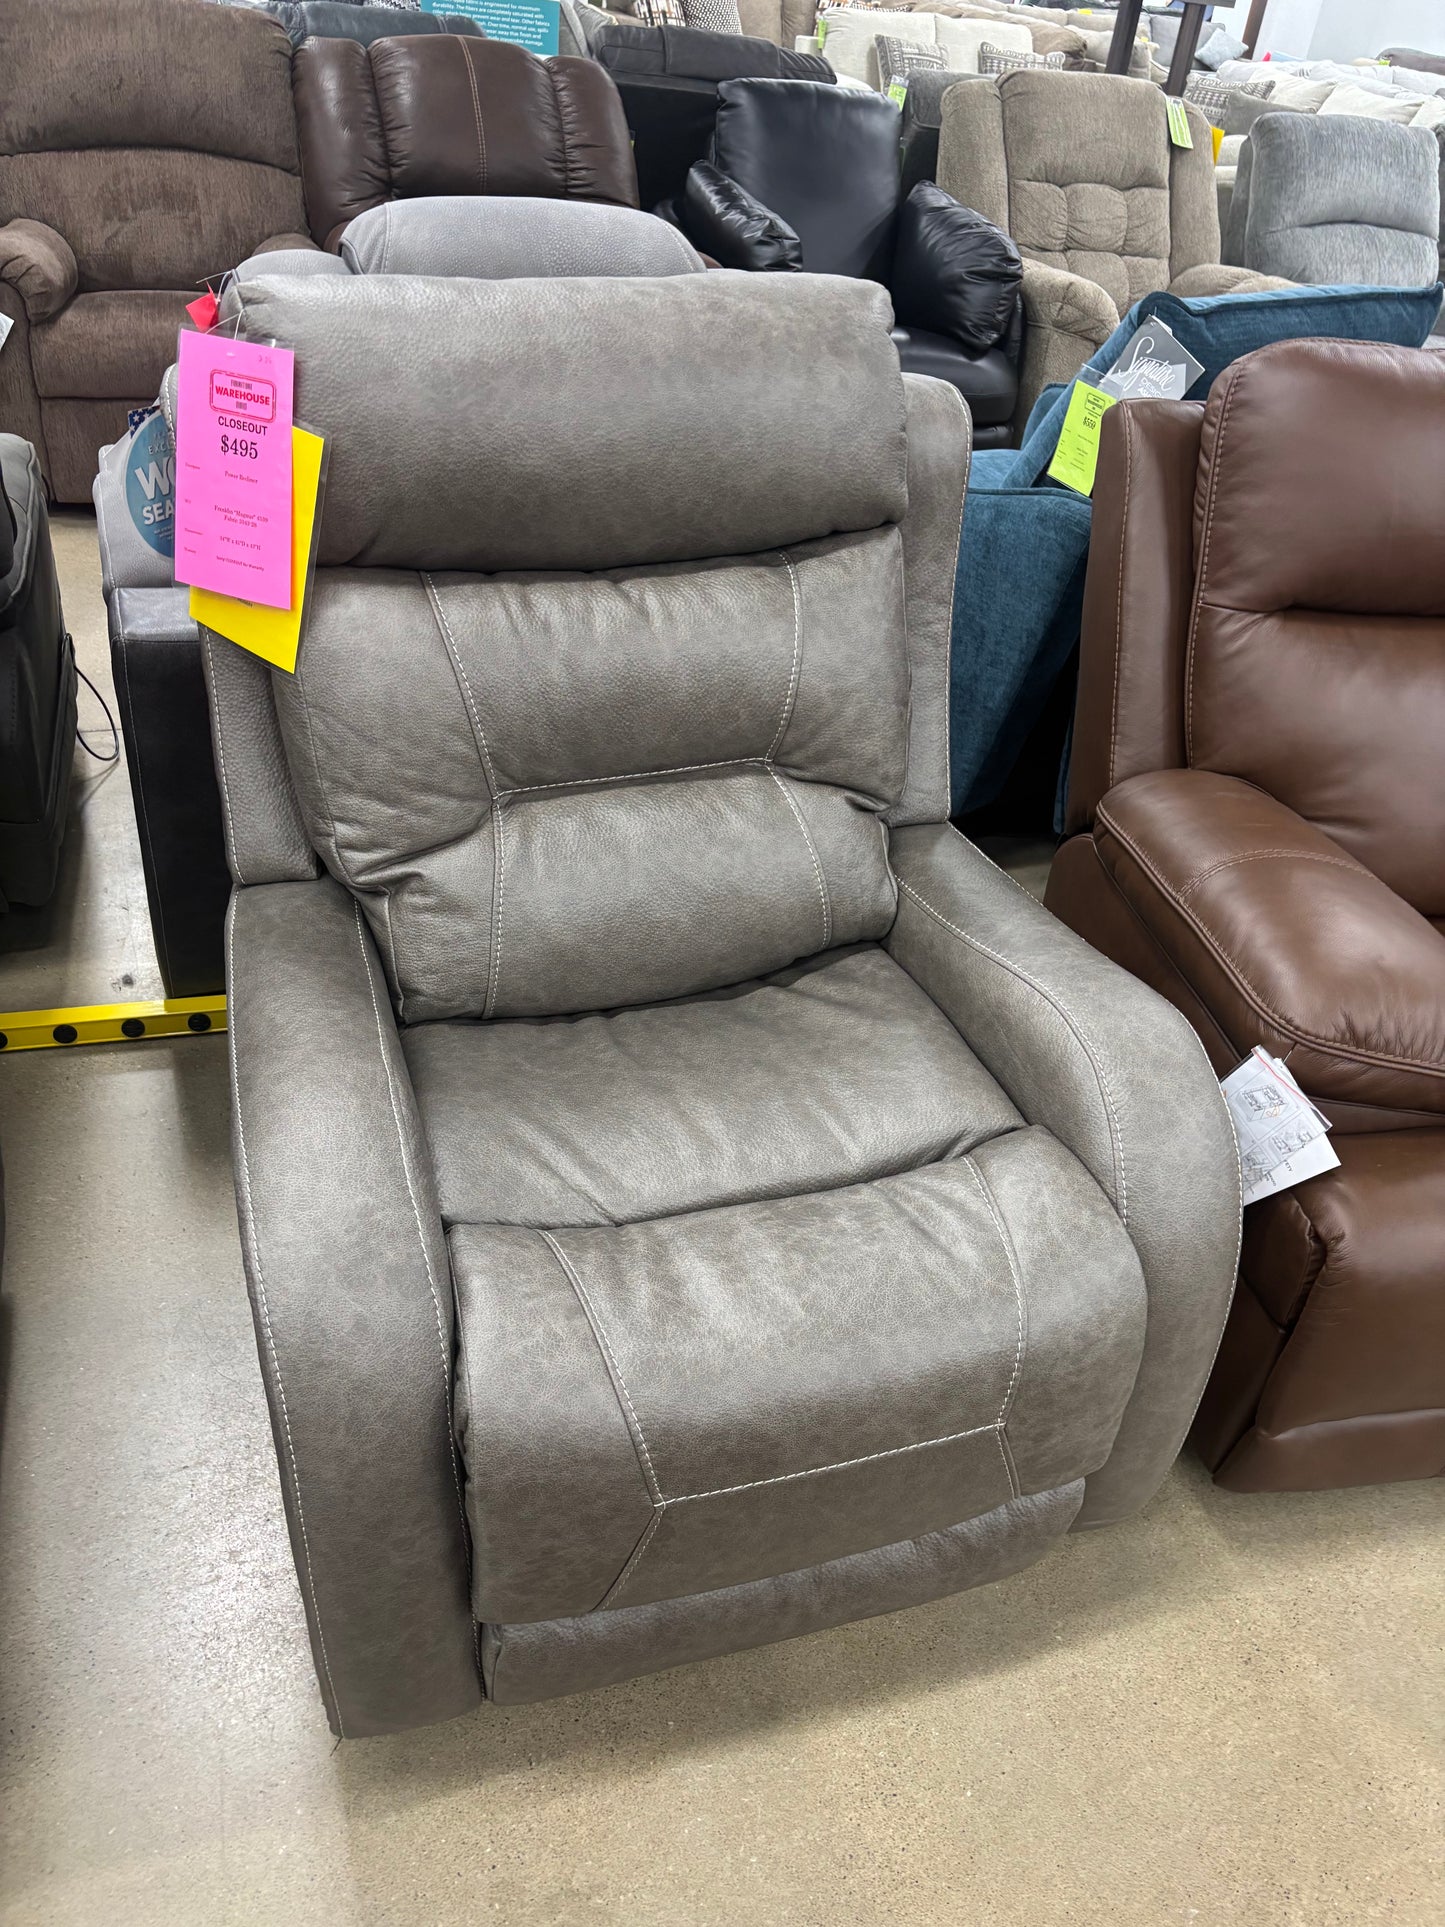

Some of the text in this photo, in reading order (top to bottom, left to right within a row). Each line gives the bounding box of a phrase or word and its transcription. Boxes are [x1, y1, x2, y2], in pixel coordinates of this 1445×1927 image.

[1118, 336, 1176, 392] Signature
[215, 386, 270, 406] WAREHOUSE
[218, 416, 268, 436] CLOSEOUT
[221, 434, 258, 459] $495
